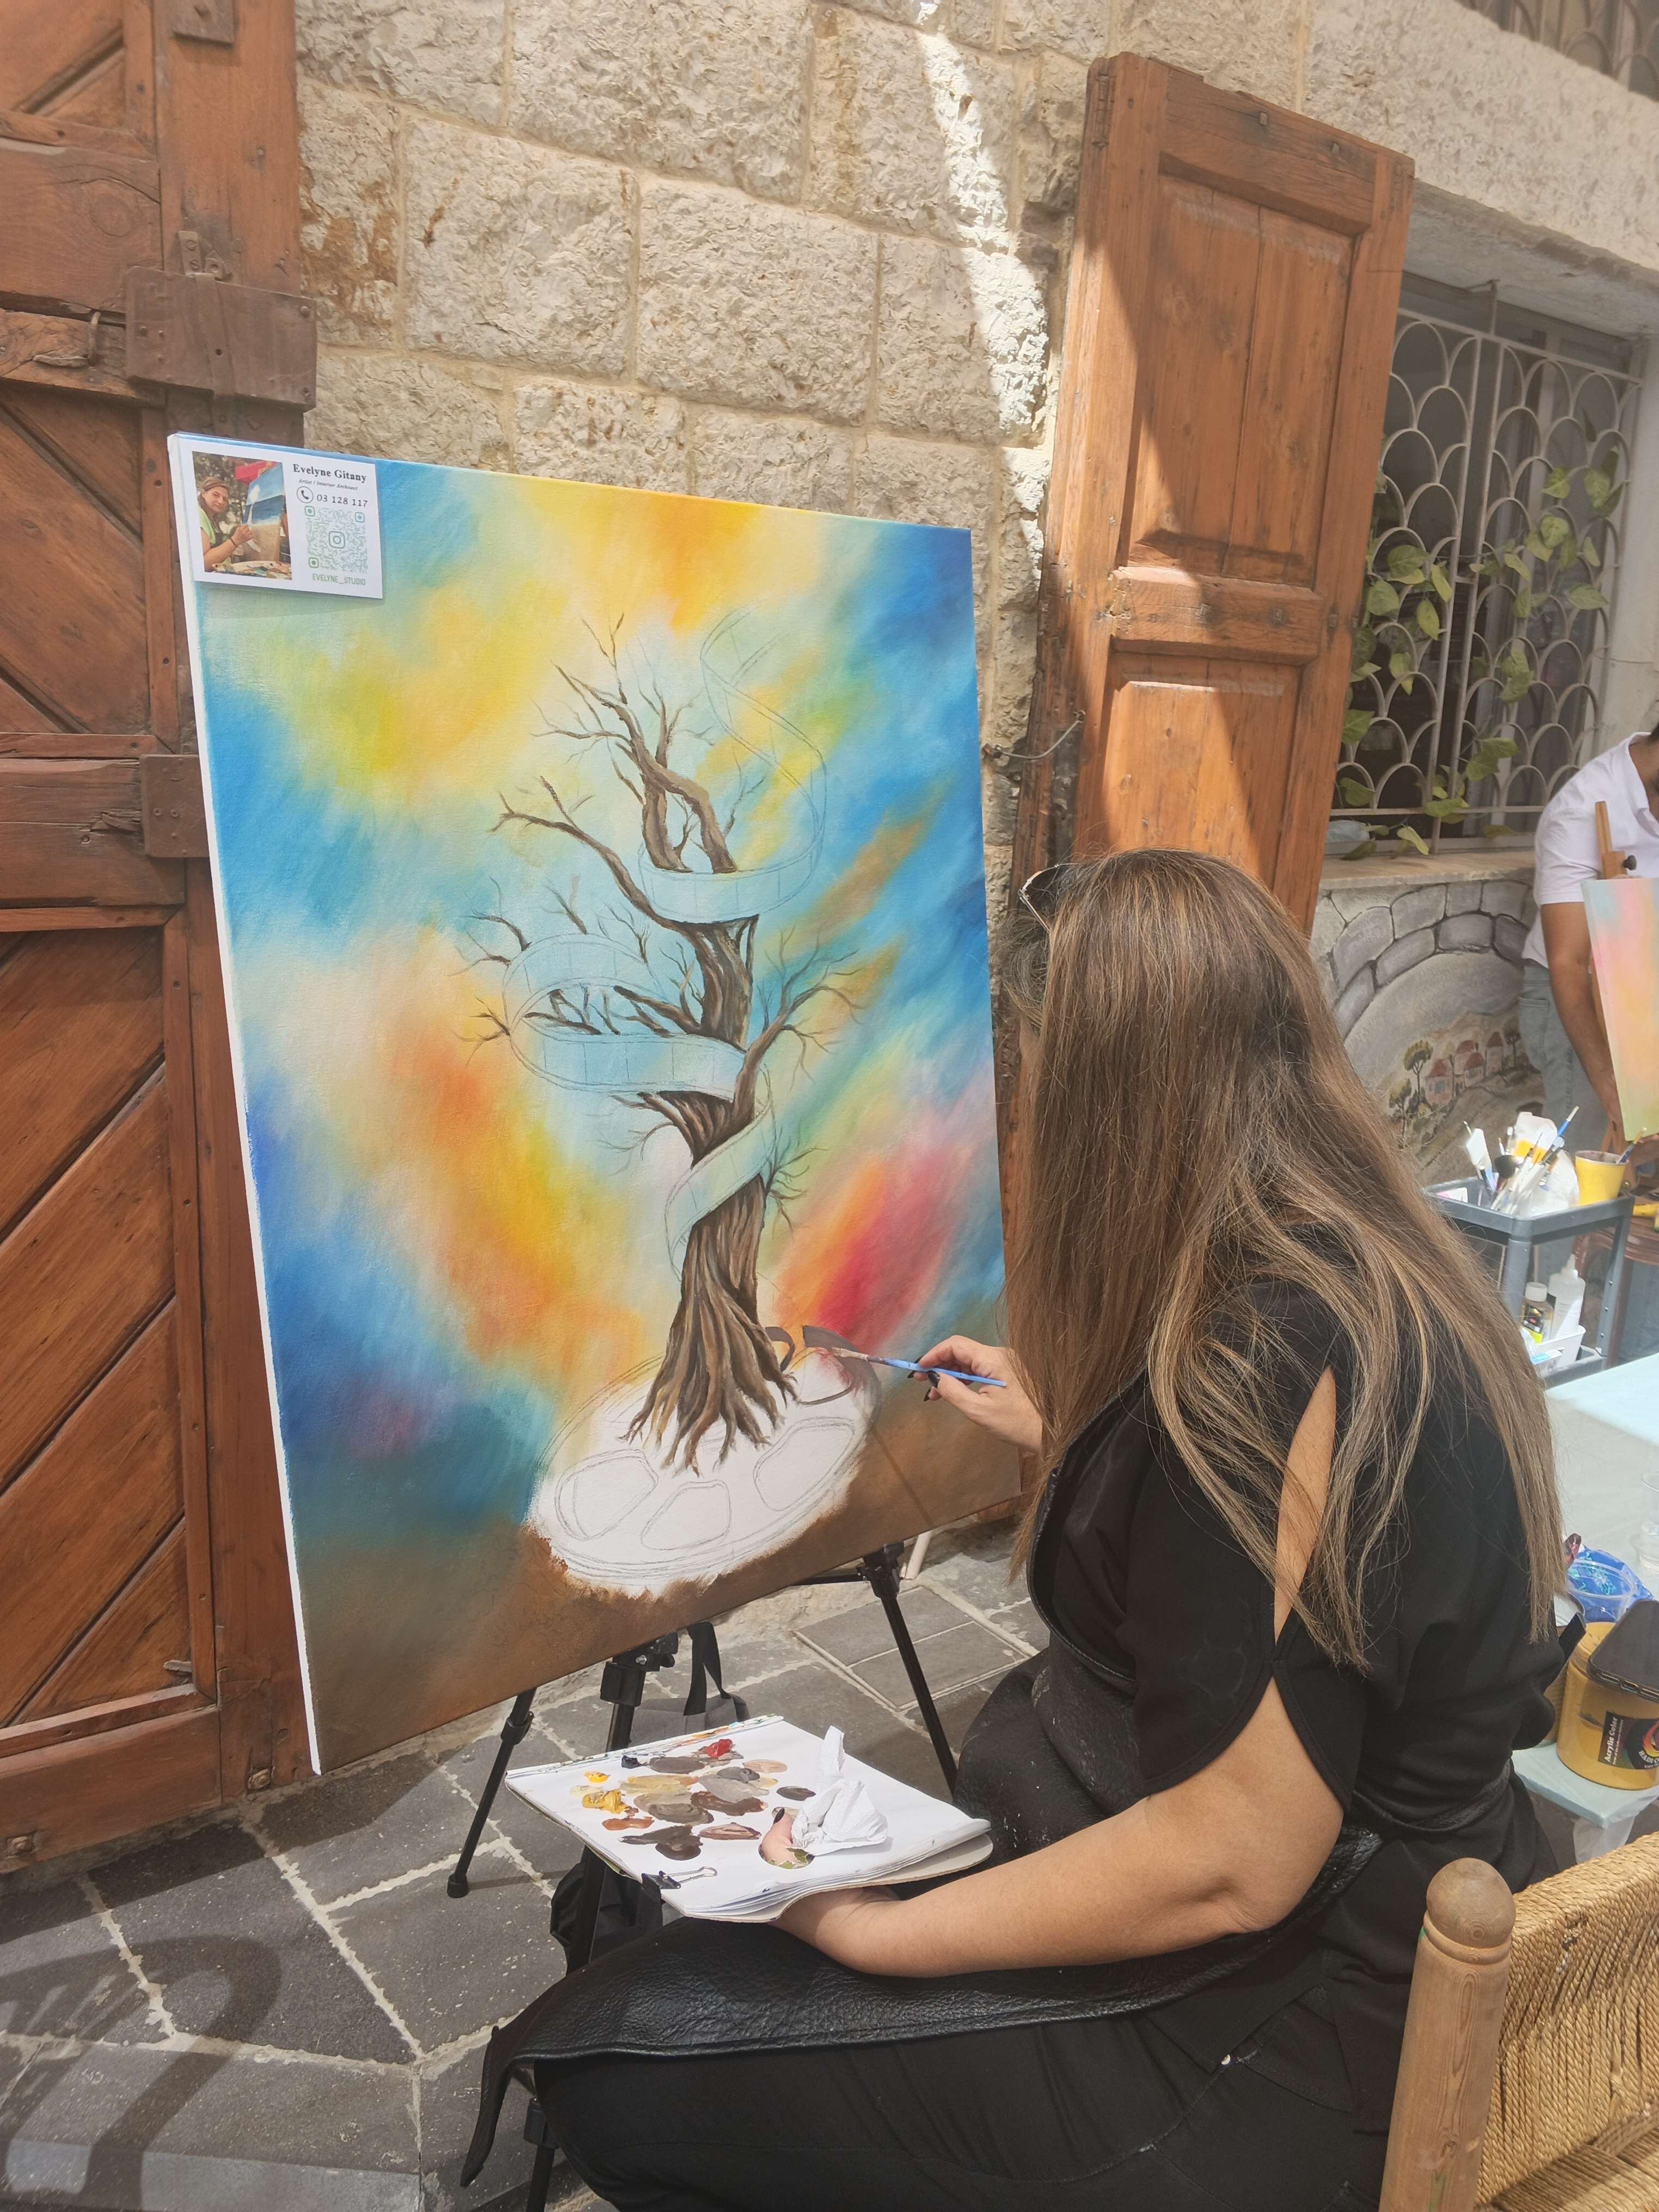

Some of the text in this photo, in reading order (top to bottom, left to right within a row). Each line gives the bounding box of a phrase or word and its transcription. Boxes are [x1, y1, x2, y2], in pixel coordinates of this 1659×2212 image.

[292, 464, 366, 483] Evelyne Gitany
[332, 496, 348, 505] 128
[352, 499, 368, 507] 117
[312, 573, 366, 586] EVELYNE_STUDIO
[1604, 1716, 1618, 1762] Acrylic Color
